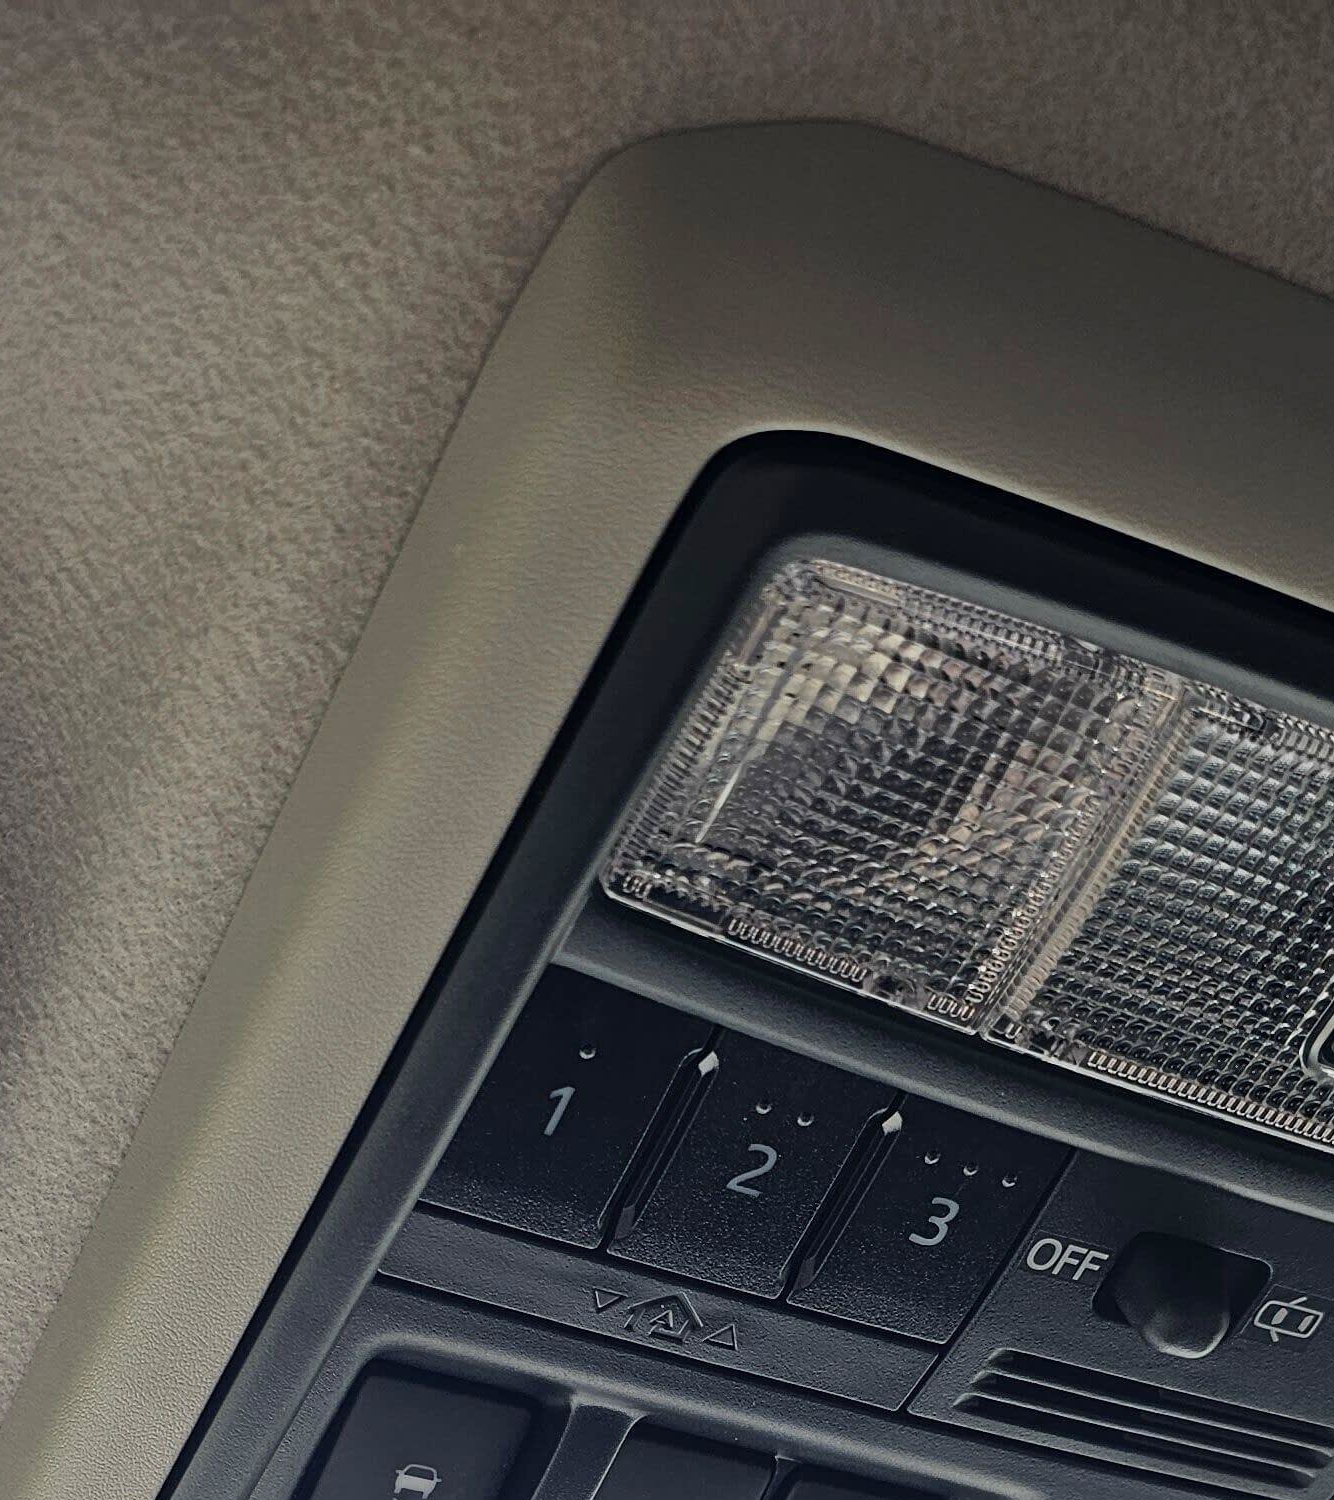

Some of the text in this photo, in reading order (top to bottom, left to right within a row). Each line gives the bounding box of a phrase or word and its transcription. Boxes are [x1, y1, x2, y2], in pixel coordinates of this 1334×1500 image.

[543, 1086, 576, 1136] 1
[725, 1142, 778, 1199] 2
[908, 1196, 960, 1248] 3
[1026, 1236, 1110, 1283] OFF
